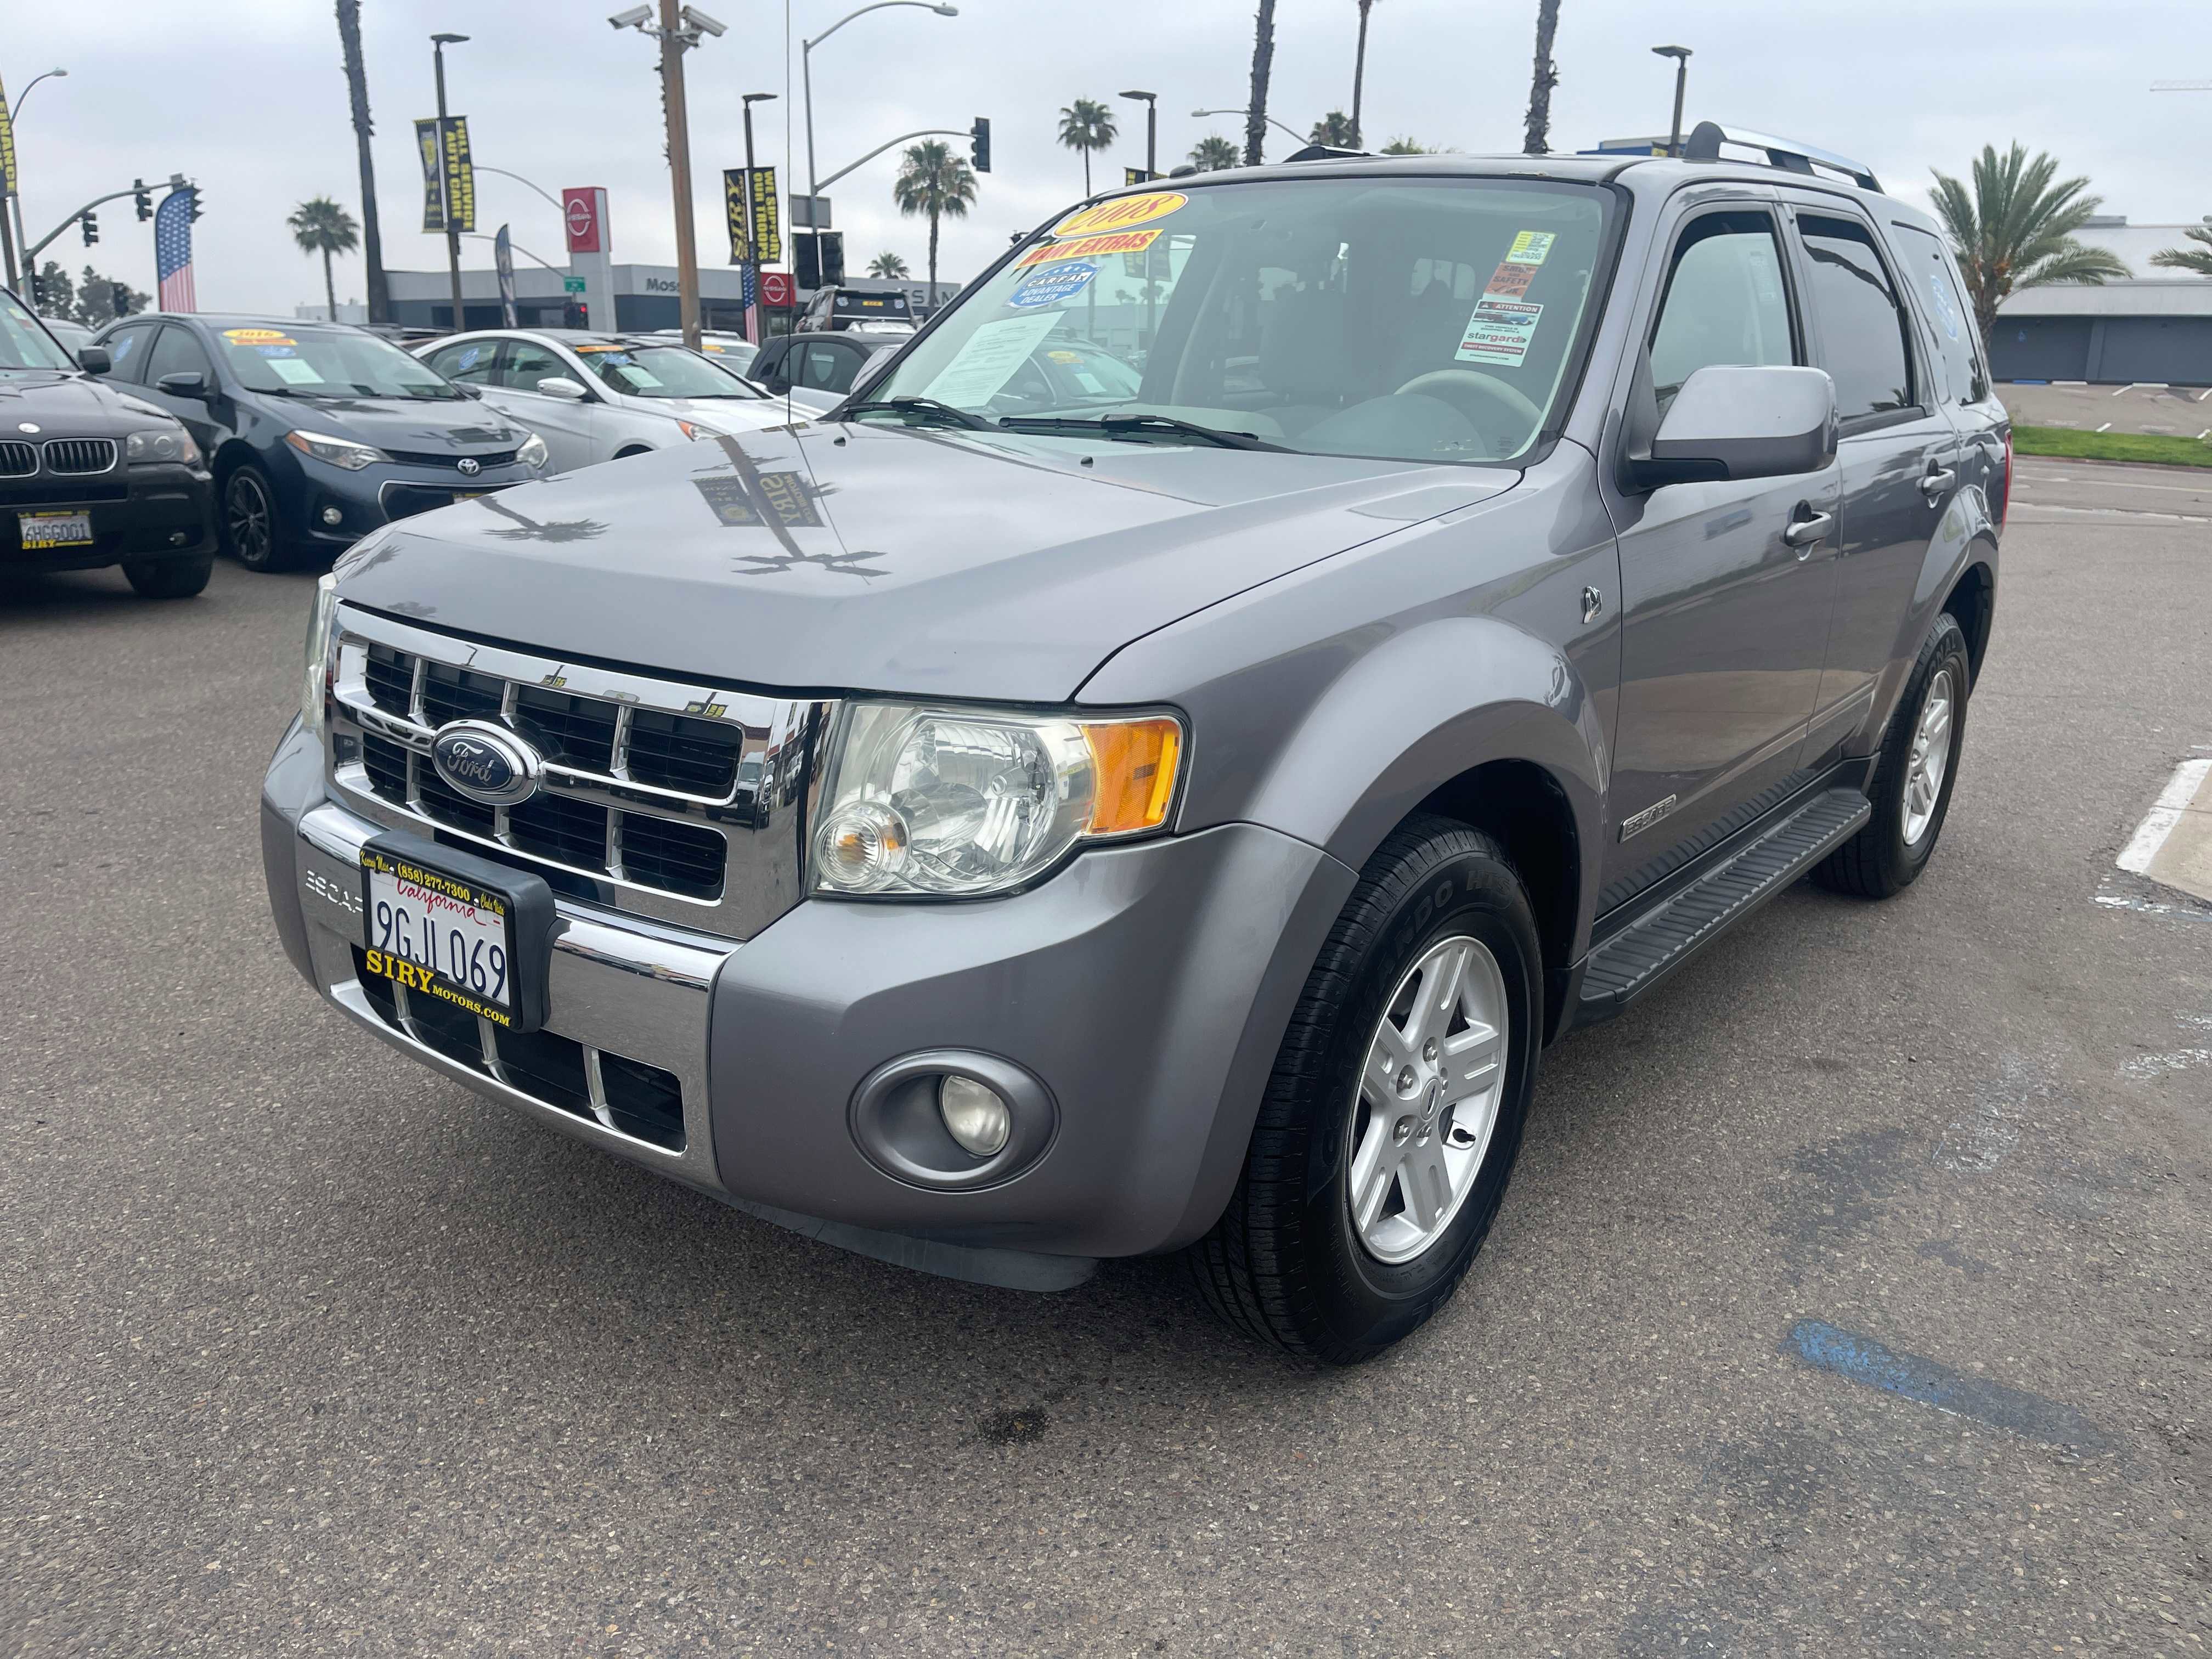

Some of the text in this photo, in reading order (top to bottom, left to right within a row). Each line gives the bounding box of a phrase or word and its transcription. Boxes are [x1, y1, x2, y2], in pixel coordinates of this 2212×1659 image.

[445, 131, 462, 219] AUTO CARE
[455, 120, 474, 229] FULL SERVICE
[753, 172, 769, 261] OUR TROOPS
[764, 171, 780, 260] WE SUPPORT
[1066, 195, 1175, 232] 2008
[1020, 231, 1156, 265] MANY EXTRAS
[1019, 284, 1075, 297] ADVANTAGE
[1020, 293, 1058, 304] DEALER
[1027, 274, 1088, 287] CARFAX
[1493, 275, 1528, 285] SAFETY
[1496, 302, 1538, 313] ATTENTION
[447, 741, 495, 782] Ford
[1626, 799, 1672, 834] ESCAPE
[306, 870, 363, 913] ESCAP
[397, 878, 487, 926] California
[1466, 870, 1510, 895] HTS
[377, 900, 506, 998] 9GJL069
[366, 949, 510, 1028] SIRY MOTORS.COM
